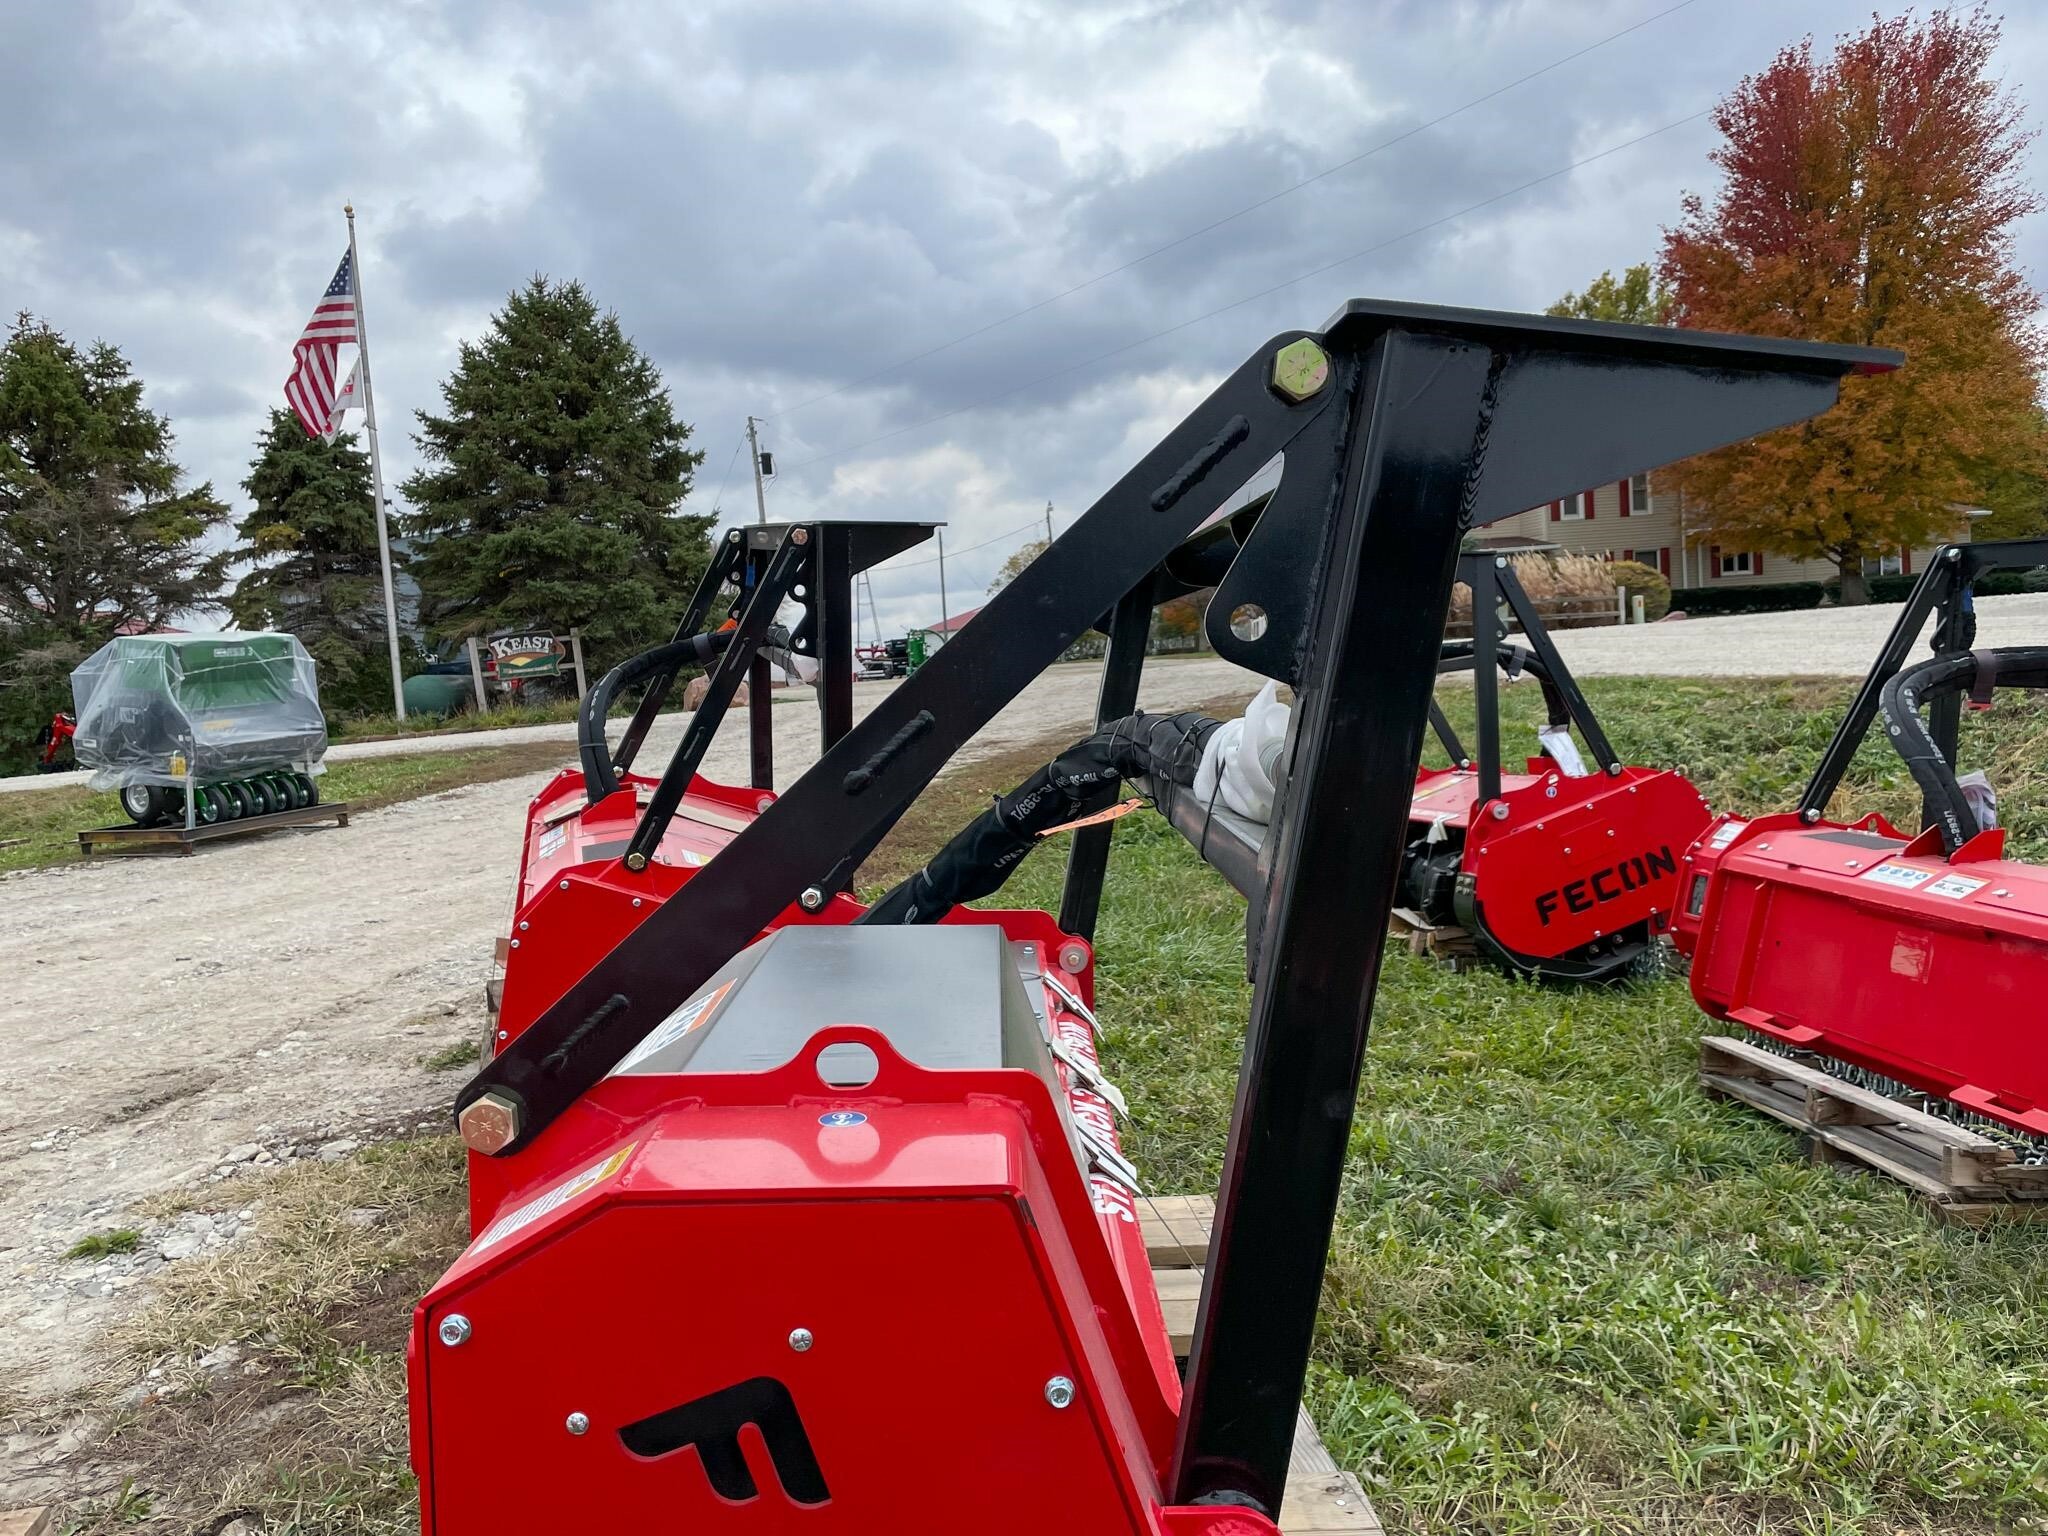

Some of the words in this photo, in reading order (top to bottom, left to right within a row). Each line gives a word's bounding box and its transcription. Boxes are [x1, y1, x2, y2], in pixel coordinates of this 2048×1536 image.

[490, 636, 553, 658] KEAST
[1535, 845, 1677, 927] FECON
[1072, 1099, 1117, 1149] ACK
[1090, 1173, 1135, 1223] STA
